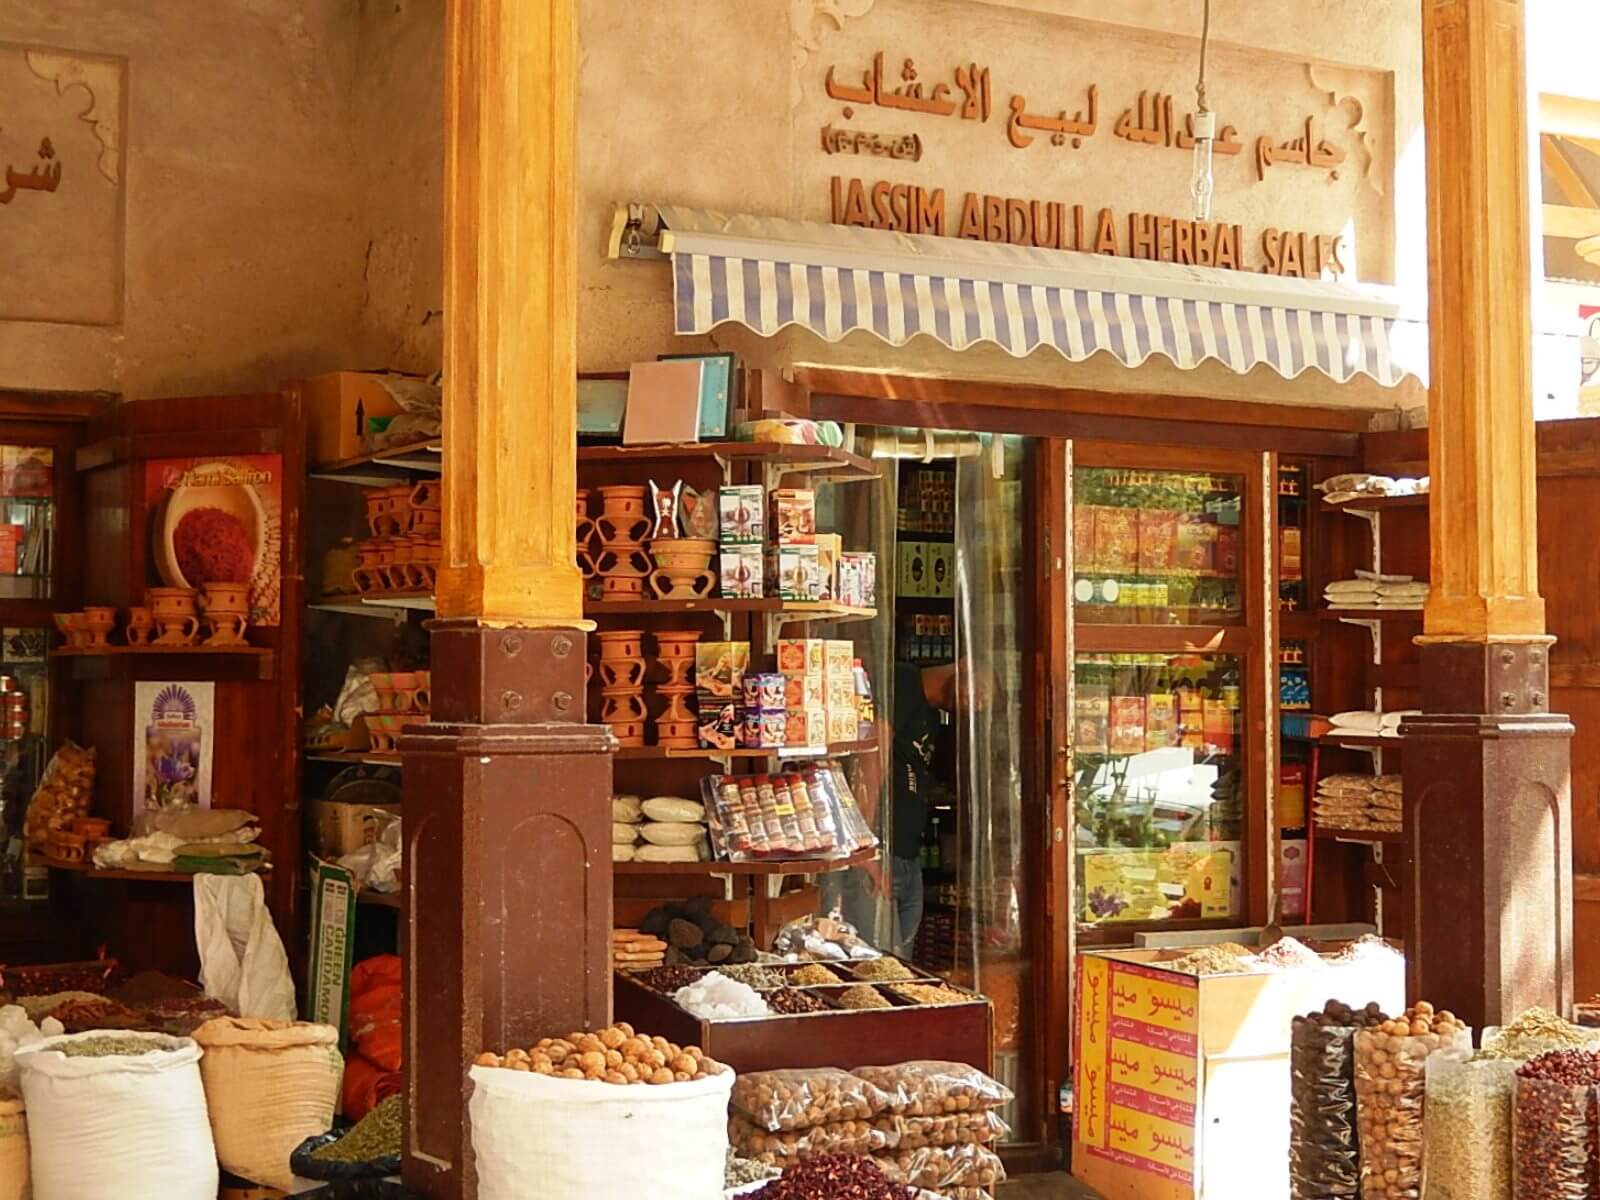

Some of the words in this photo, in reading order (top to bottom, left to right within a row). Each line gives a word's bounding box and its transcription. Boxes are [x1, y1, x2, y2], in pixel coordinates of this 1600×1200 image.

[825, 52, 992, 123] الاعشاب
[1007, 84, 1099, 149] لبيع
[1114, 90, 1243, 156] عدالله
[1256, 115, 1346, 181] جاسم
[958, 192, 1120, 256] ABDULLA
[1128, 212, 1254, 270] HERBAL
[1262, 227, 1345, 281] SALES
[331, 926, 346, 987] GREEN
